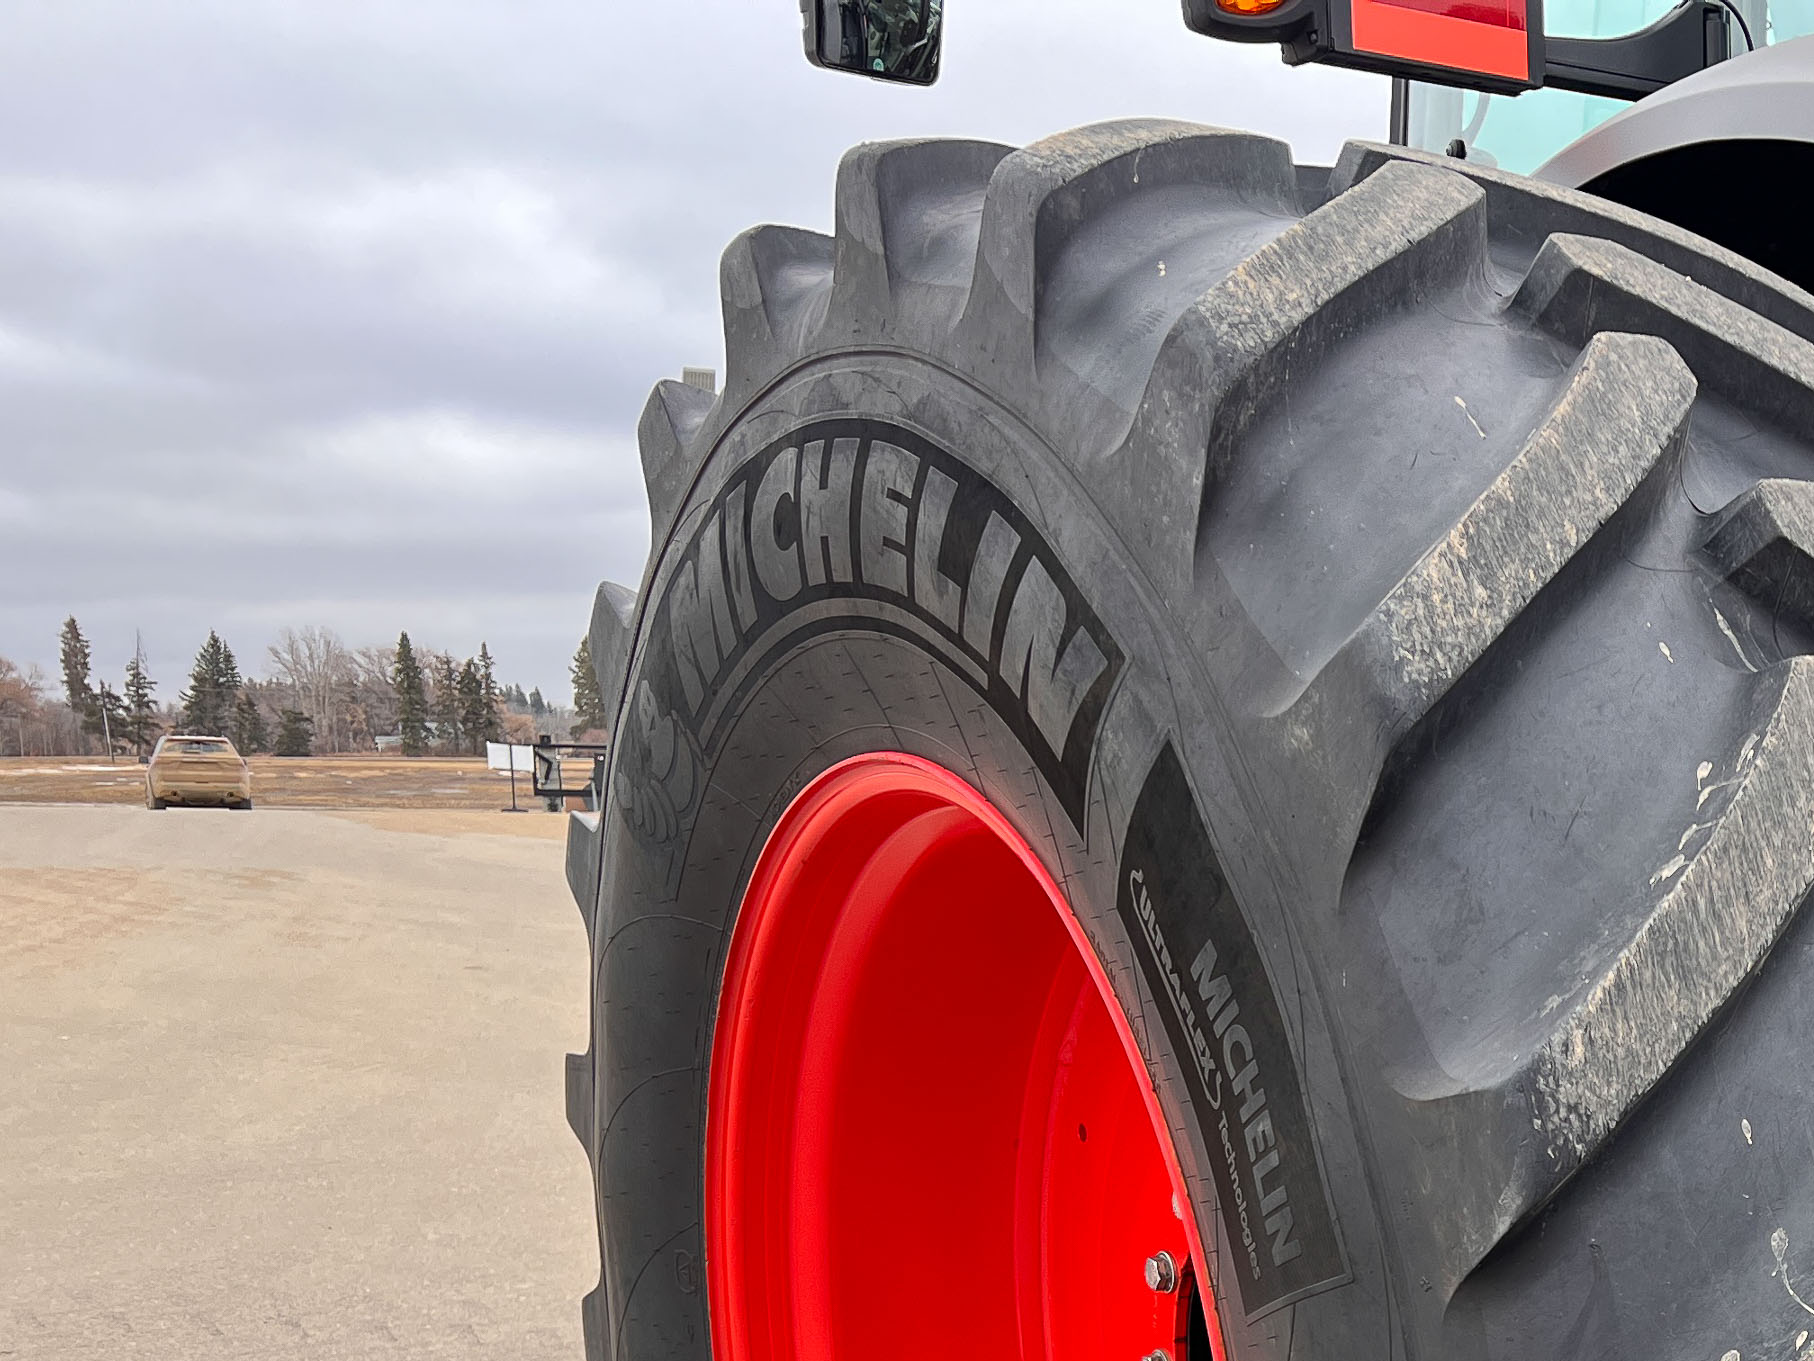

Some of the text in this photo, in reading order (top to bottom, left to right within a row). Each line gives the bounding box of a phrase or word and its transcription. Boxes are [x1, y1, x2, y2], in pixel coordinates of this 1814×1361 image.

[668, 437, 1110, 763] MICHELIN
[1138, 888, 1261, 1281] ULTRAFLEX Technologies
[1190, 939, 1301, 1267] MICHELIN
